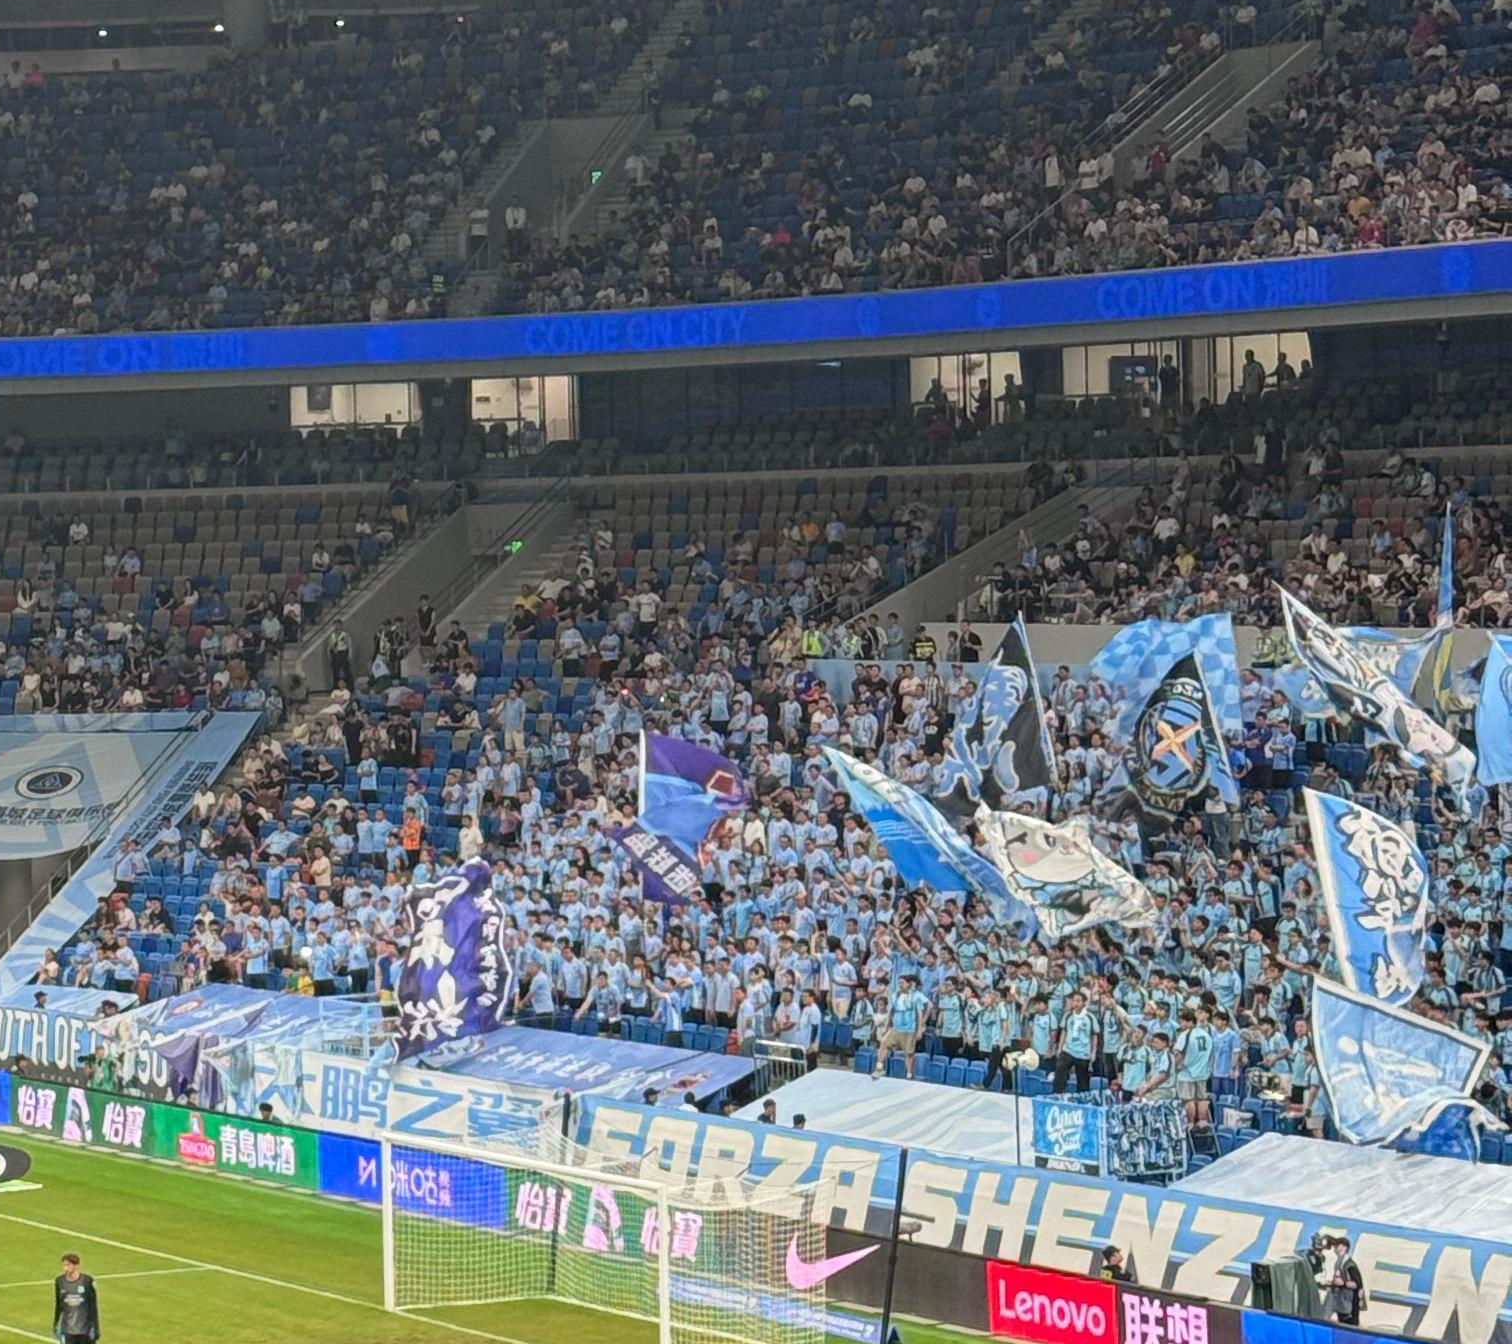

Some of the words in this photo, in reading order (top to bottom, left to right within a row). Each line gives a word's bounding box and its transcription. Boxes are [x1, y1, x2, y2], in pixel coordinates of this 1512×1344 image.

[1097, 275, 1192, 319] COME
[1203, 270, 1258, 312] ON
[98, 337, 160, 373] ON
[524, 317, 620, 354] COME
[628, 314, 673, 350] ON
[680, 307, 748, 346] CITY
[590, 1105, 881, 1232] FORZA
[999, 1278, 1106, 1338] Lenovo
